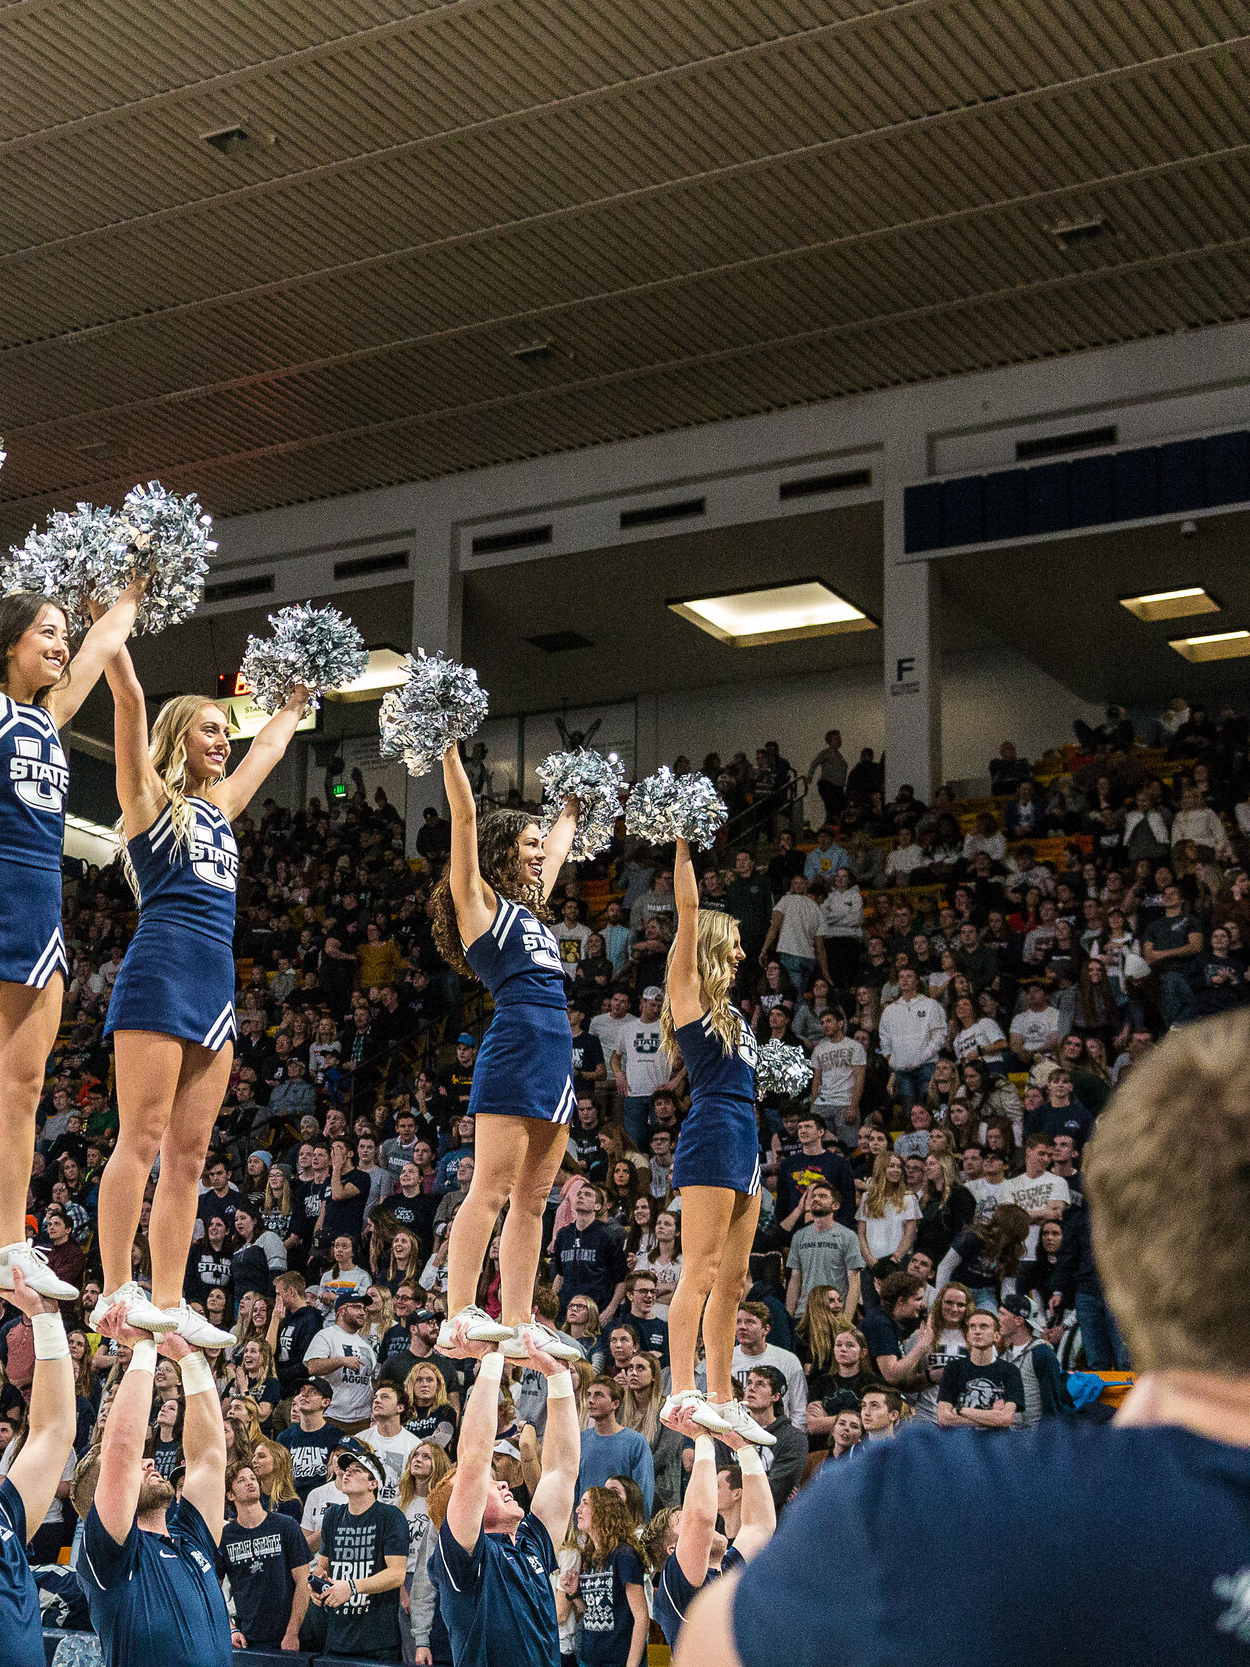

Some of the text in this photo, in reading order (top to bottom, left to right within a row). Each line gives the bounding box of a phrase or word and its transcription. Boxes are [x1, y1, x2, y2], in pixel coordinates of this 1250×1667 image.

[897, 658, 915, 682] F
[10, 757, 69, 794] STATE
[189, 841, 239, 877] STATE
[253, 1534, 282, 1556] STATE
